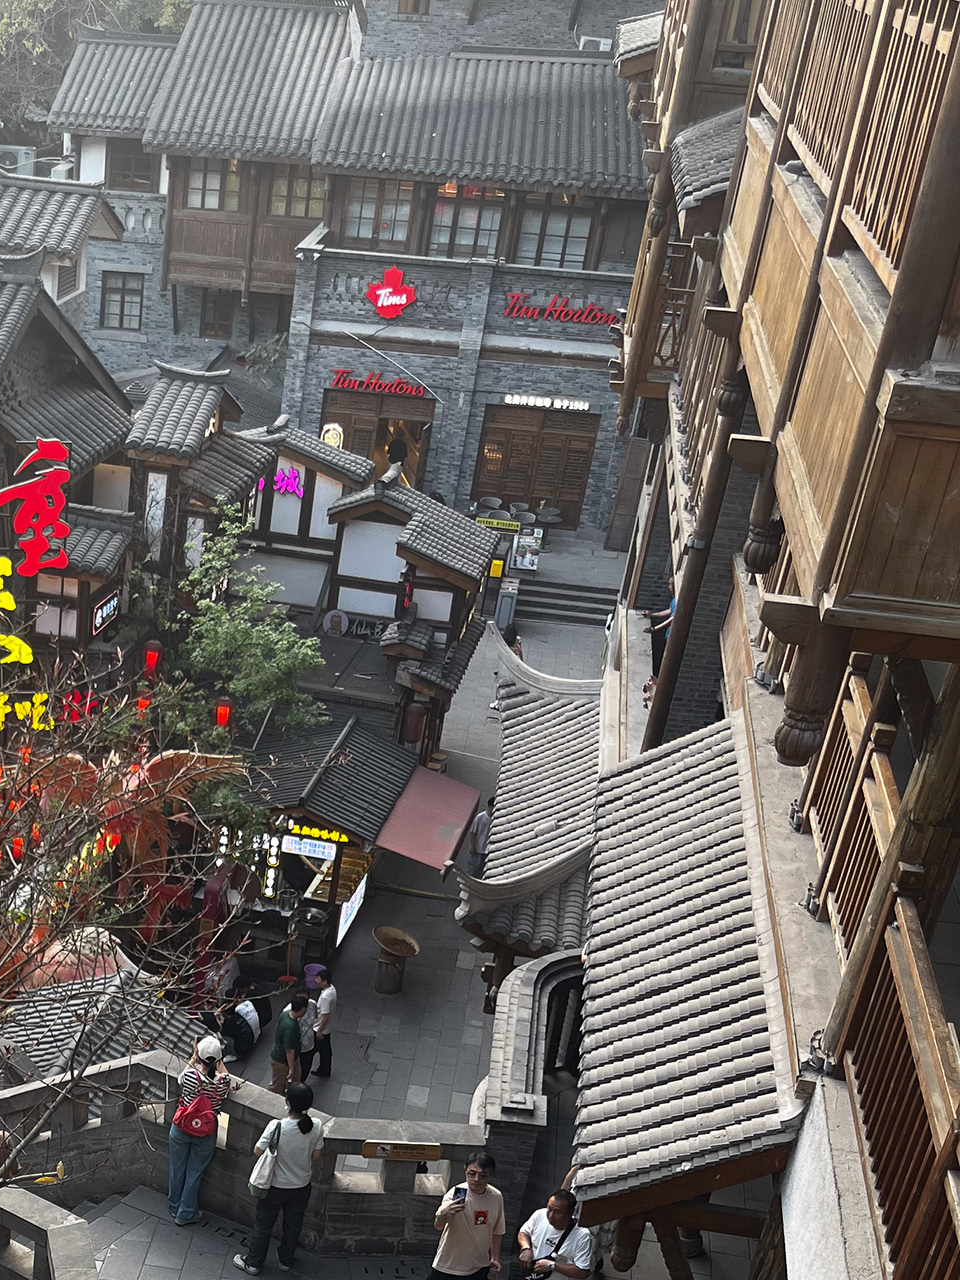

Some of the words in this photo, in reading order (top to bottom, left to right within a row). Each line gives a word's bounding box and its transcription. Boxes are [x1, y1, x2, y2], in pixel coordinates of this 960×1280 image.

[376, 288, 407, 307] Tims
[503, 292, 541, 320] Tim
[331, 368, 359, 391] Tim
[361, 370, 425, 397] Hortons
